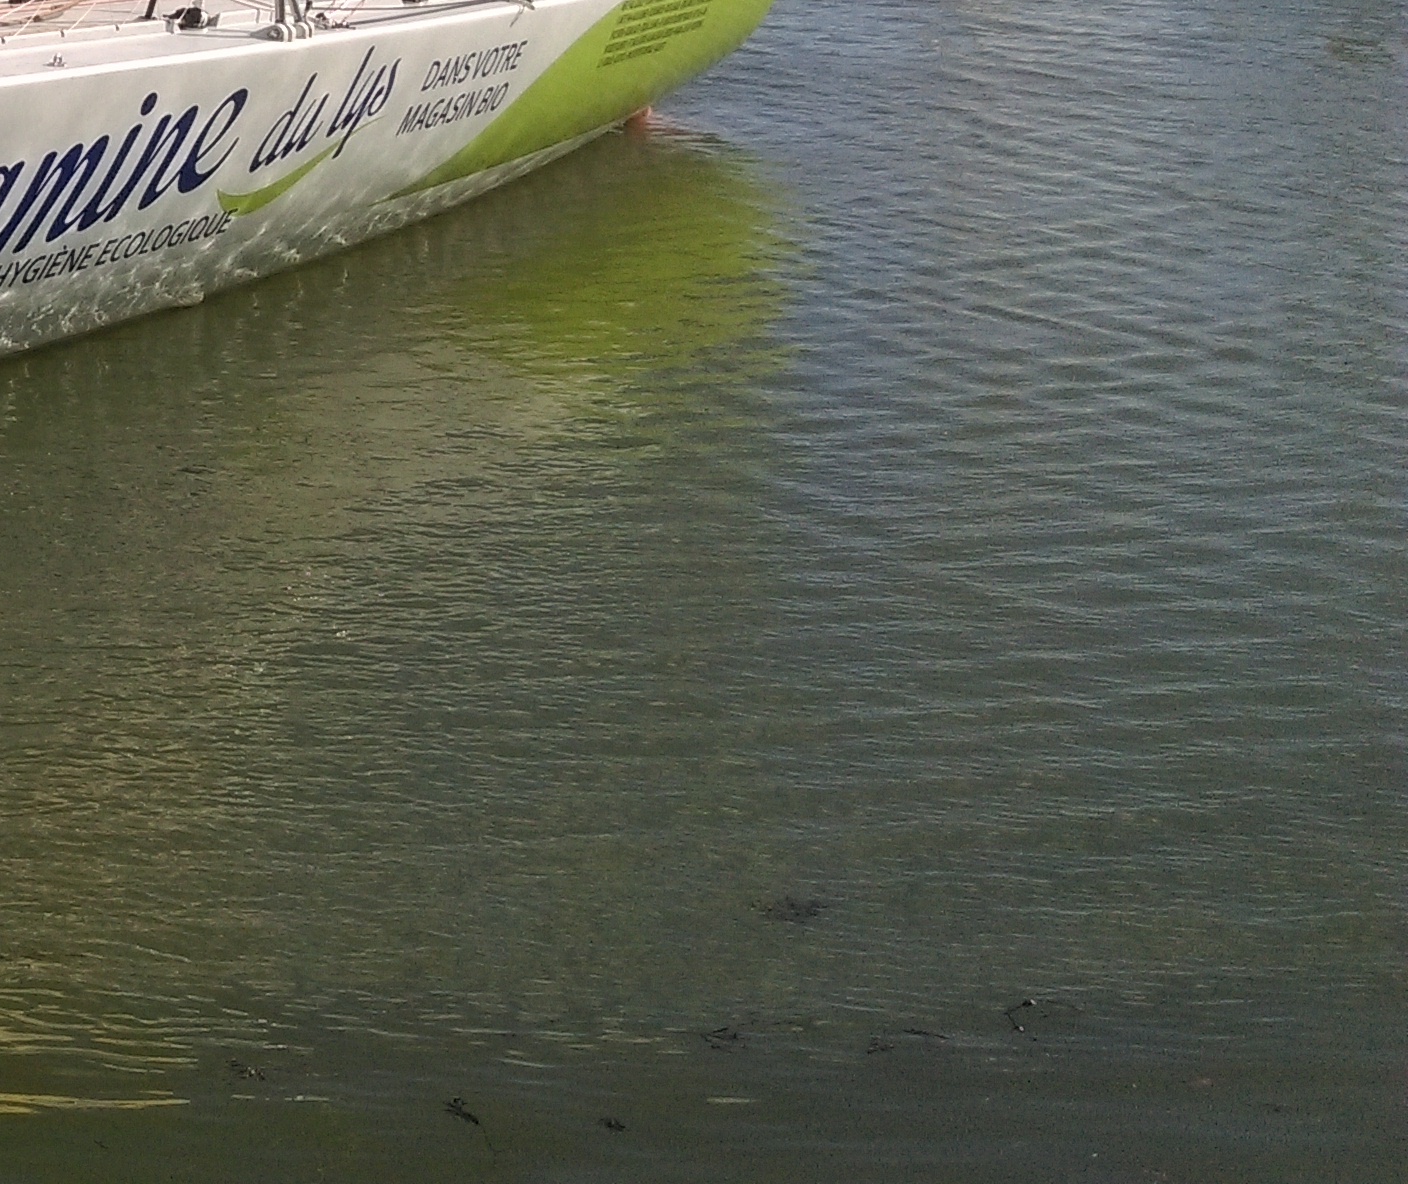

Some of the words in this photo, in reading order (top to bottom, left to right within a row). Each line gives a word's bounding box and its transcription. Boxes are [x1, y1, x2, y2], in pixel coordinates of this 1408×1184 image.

[249, 72, 330, 174] du
[326, 45, 403, 159] lys
[396, 92, 478, 136] MAGASIN
[95, 207, 237, 266] ECOLOGIQUE
